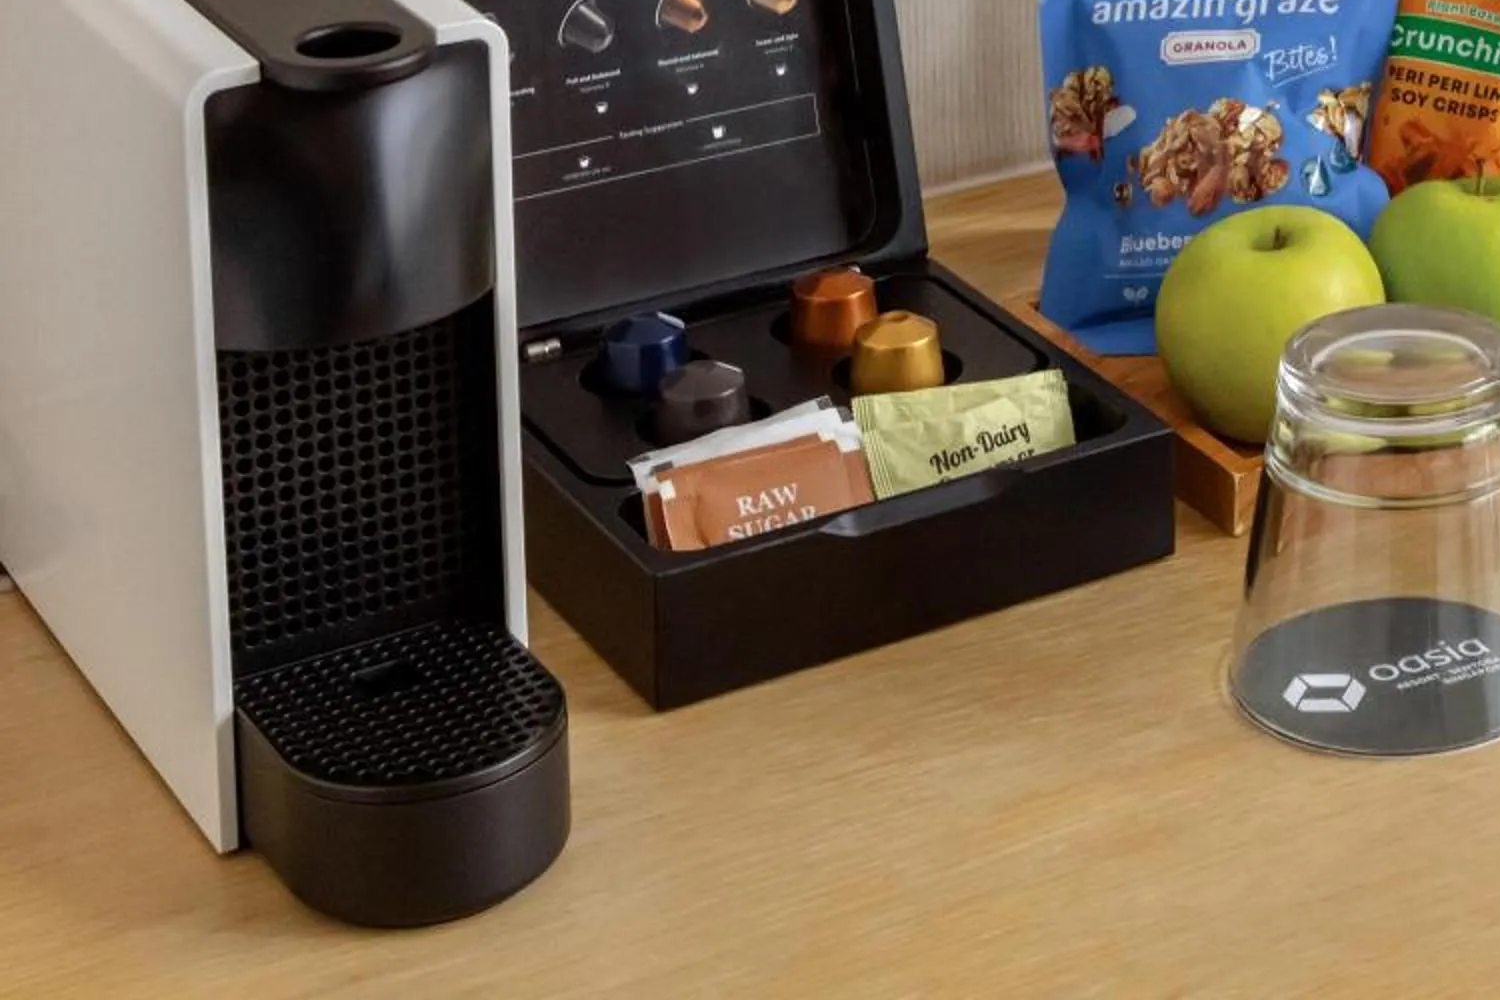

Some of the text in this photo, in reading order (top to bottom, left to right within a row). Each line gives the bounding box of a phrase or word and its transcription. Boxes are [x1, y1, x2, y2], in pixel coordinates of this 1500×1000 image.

[1172, 38, 1249, 54] GRANOLA
[1263, 36, 1338, 82] Bites!
[1428, 74, 1470, 96] PERI
[1391, 86, 1500, 124] SOY CRISPS
[929, 421, 1031, 475] Non-Dairy
[735, 482, 799, 517] RAW
[727, 504, 818, 540] SUGAR
[1368, 637, 1492, 681] oasia
